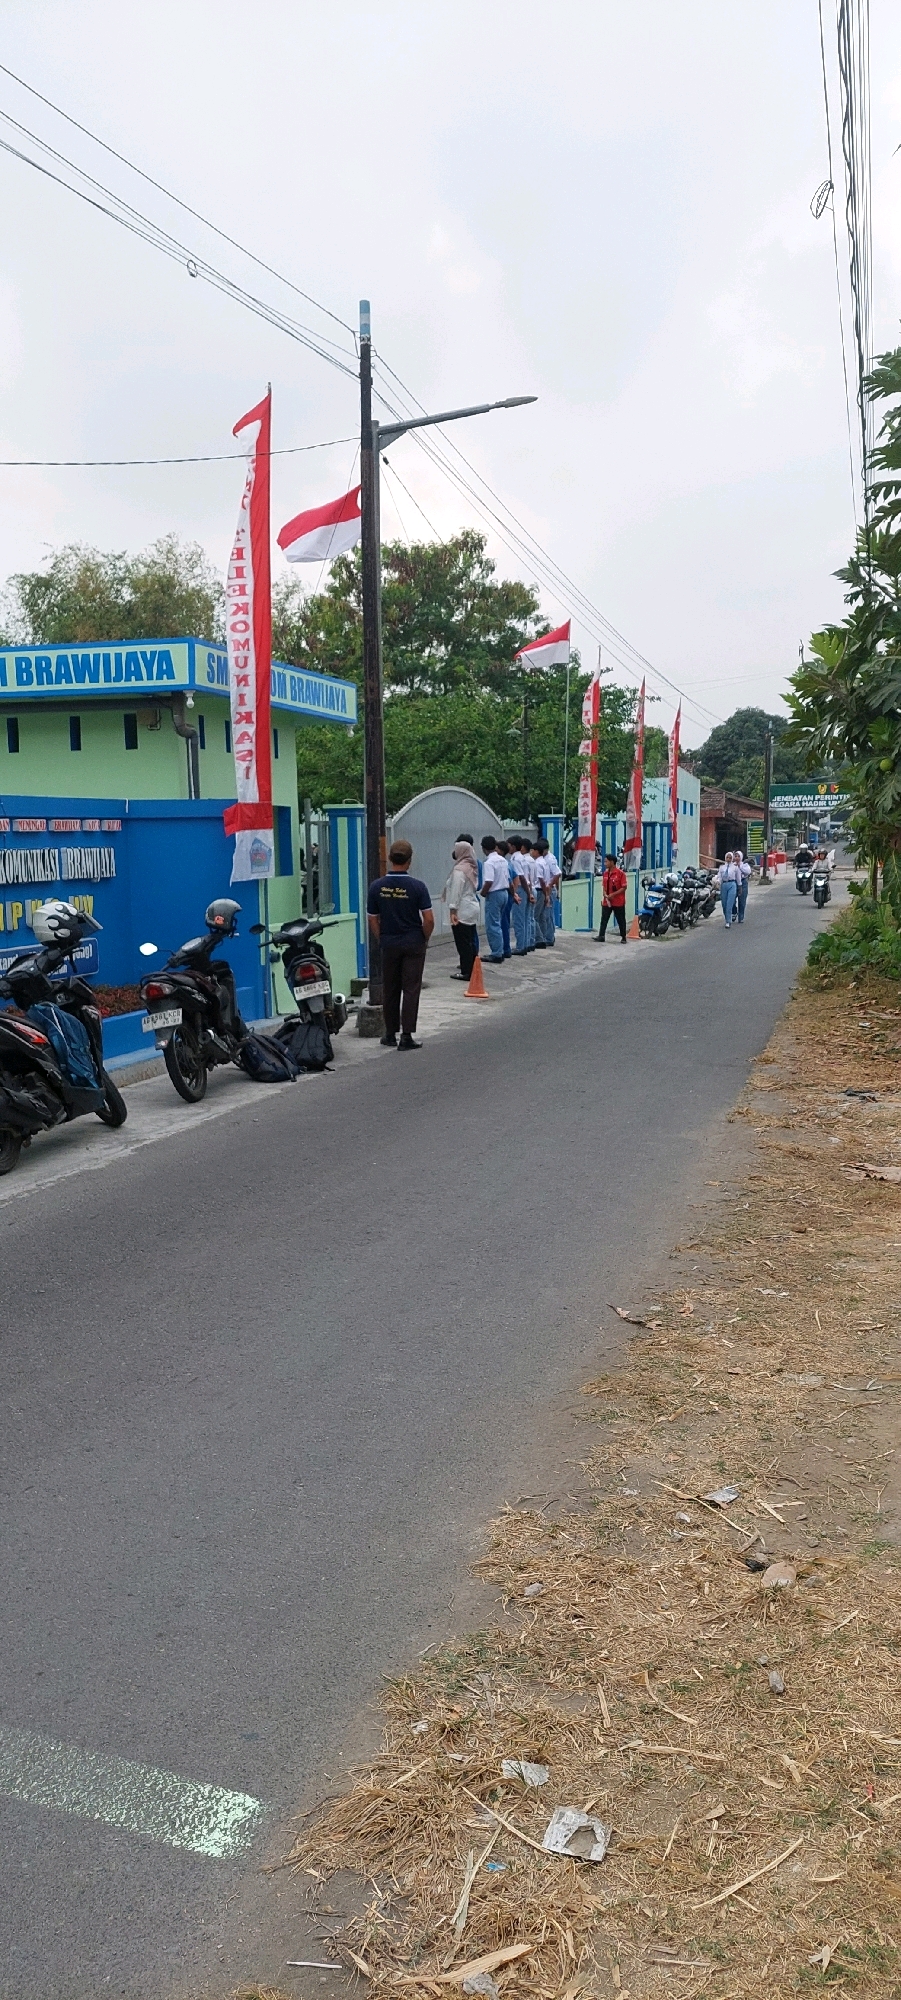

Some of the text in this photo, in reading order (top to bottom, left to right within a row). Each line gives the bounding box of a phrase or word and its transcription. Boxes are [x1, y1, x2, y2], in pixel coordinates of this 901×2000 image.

[15, 650, 175, 686] BRAWIJAYA
[206, 652, 229, 686] SM
[290, 675, 347, 713] BRAWIJAYA
[66, 846, 116, 882] BRAWIJAYA
